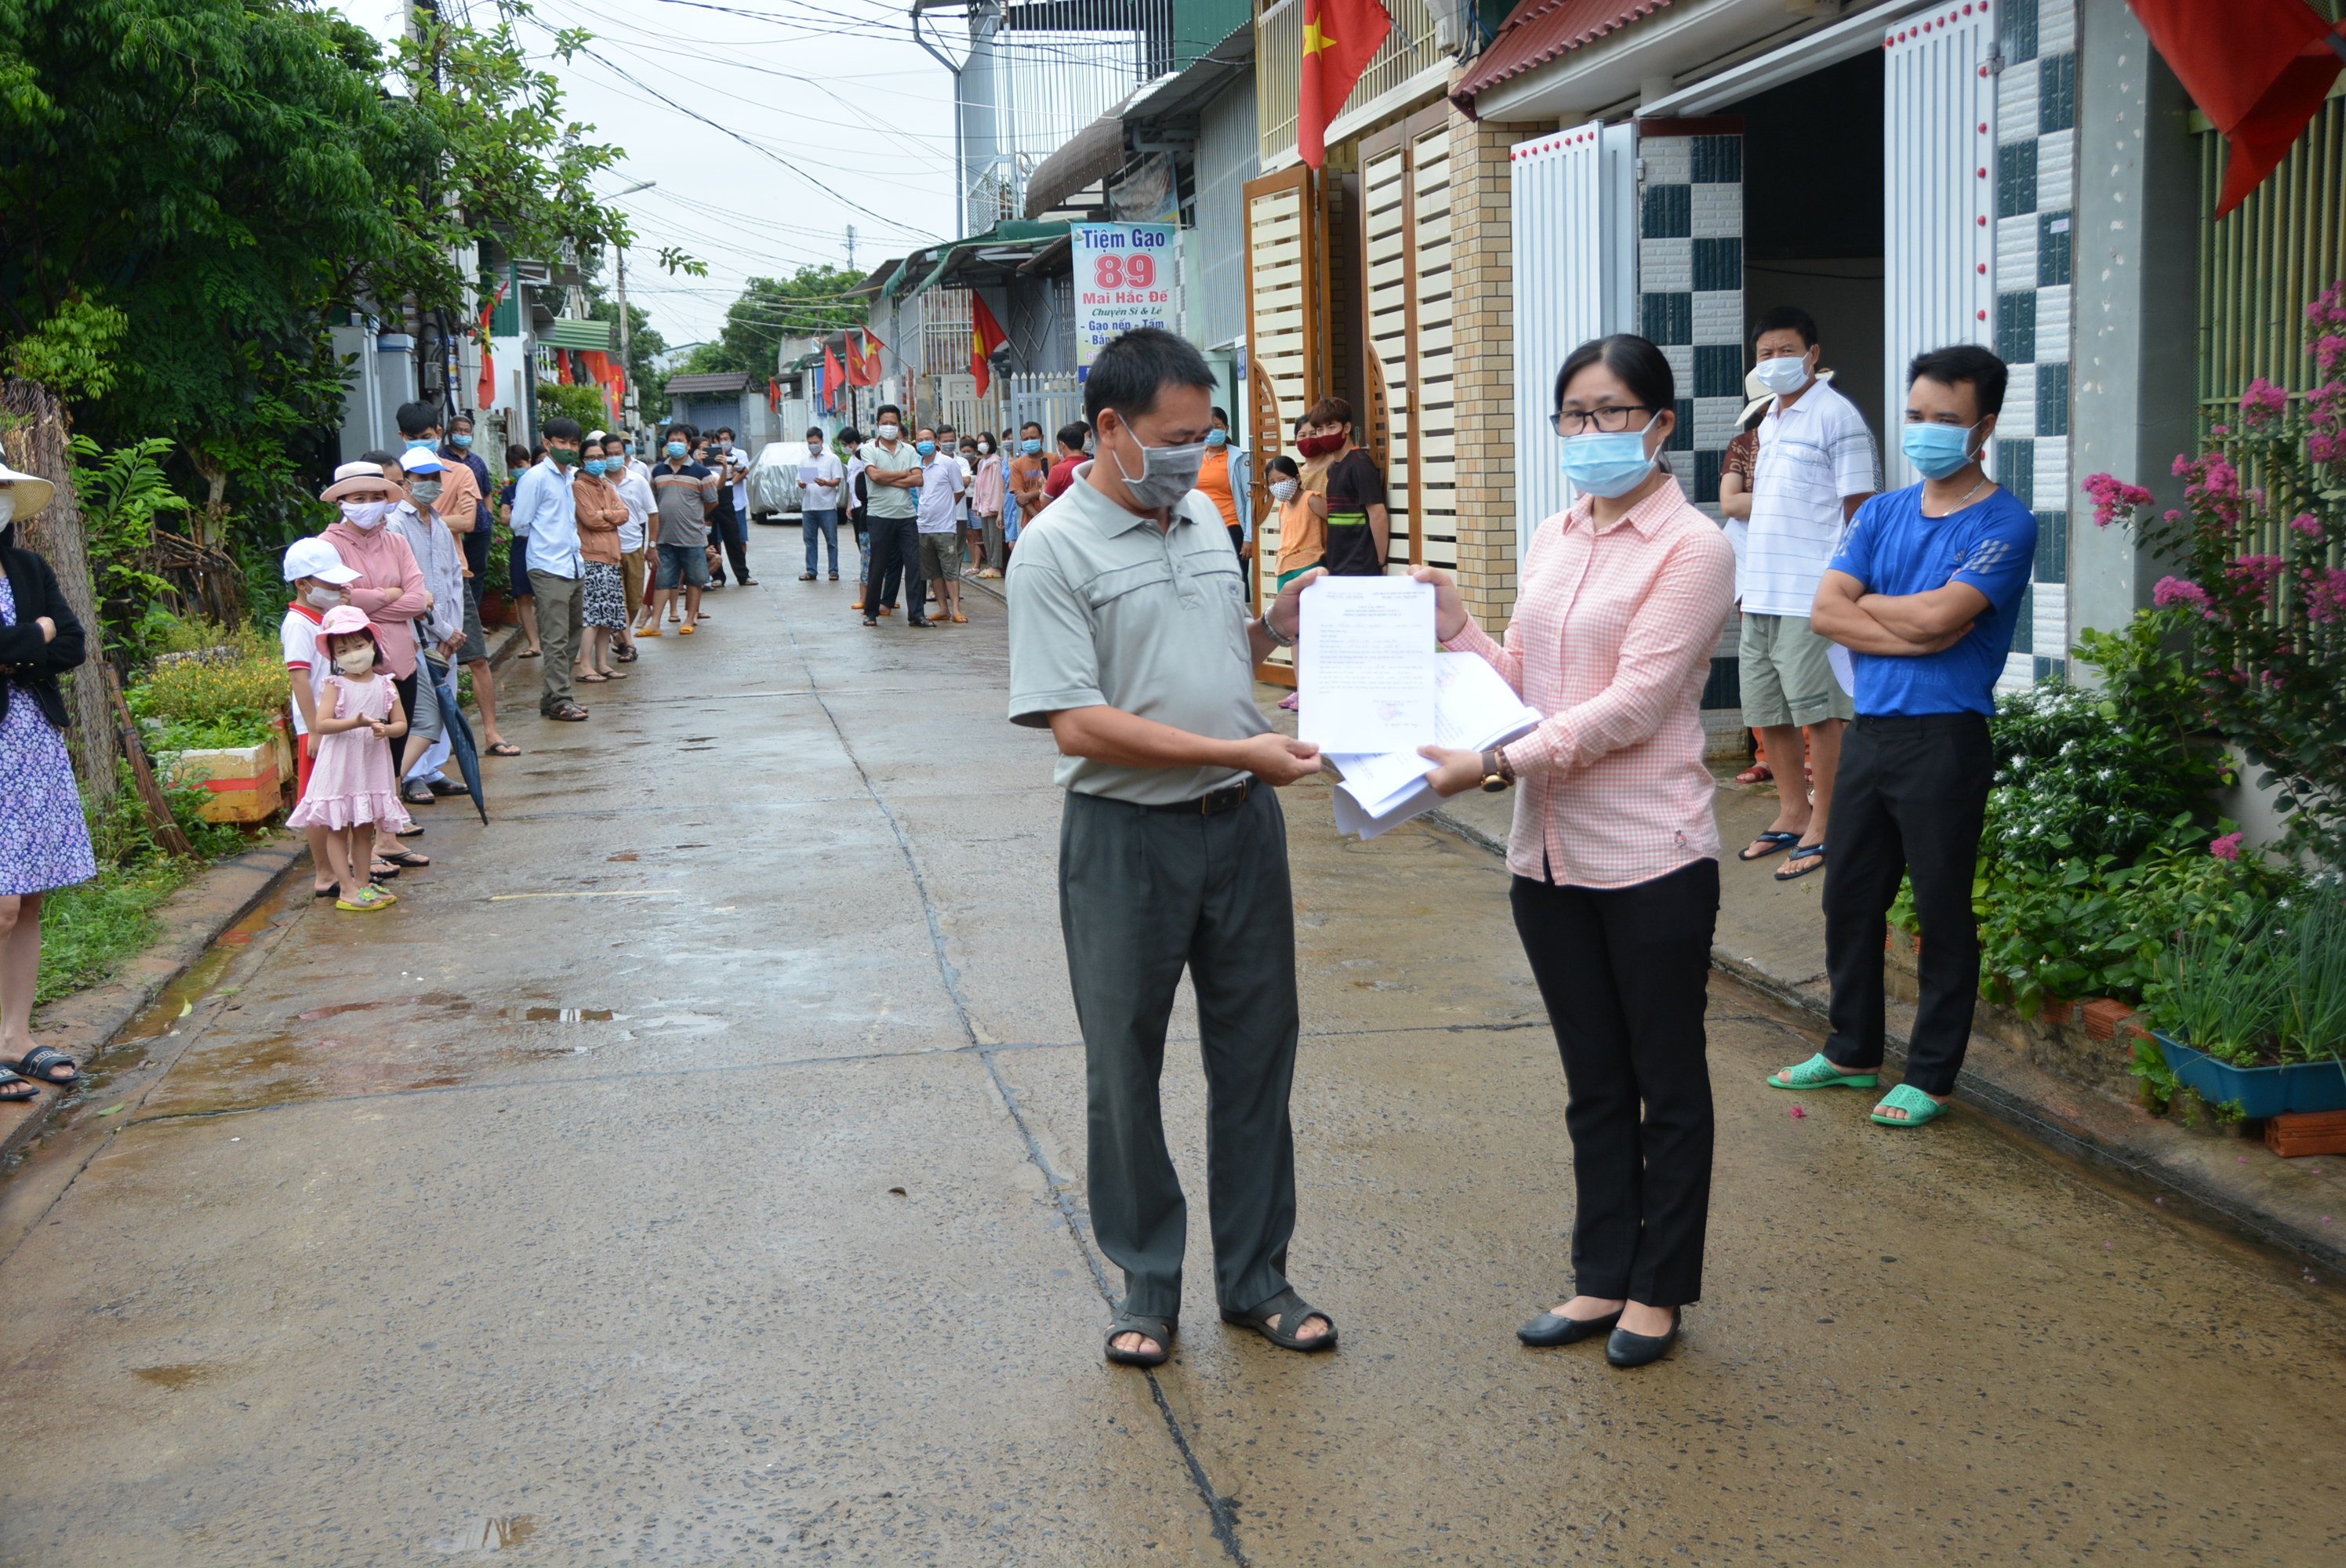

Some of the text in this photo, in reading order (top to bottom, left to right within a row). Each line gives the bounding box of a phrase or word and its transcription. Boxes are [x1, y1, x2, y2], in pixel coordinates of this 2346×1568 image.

[1082, 228, 1165, 253] Tiệm Gạo
[1095, 252, 1157, 290] 89
[1083, 289, 1170, 304] Mai Hắc Đế
[1092, 307, 1127, 318] Chuyên
[1089, 321, 1109, 334] Gạo
